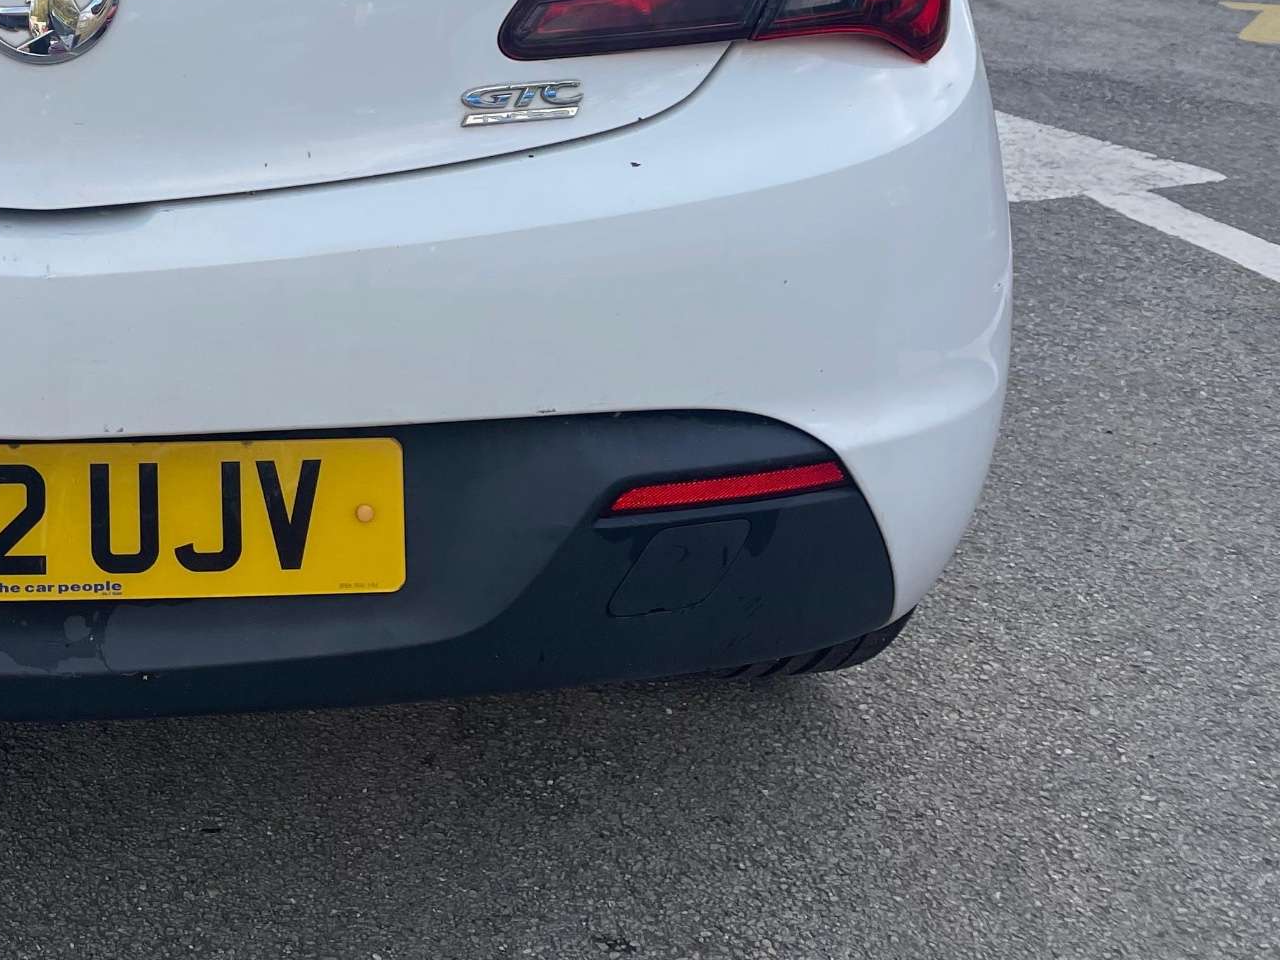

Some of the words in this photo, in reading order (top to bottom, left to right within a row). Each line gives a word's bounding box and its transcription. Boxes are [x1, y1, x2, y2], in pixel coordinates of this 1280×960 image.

[461, 80, 584, 109] GTC
[89, 458, 322, 575] UJV
[25, 583, 55, 593] car
[58, 581, 122, 594] people
